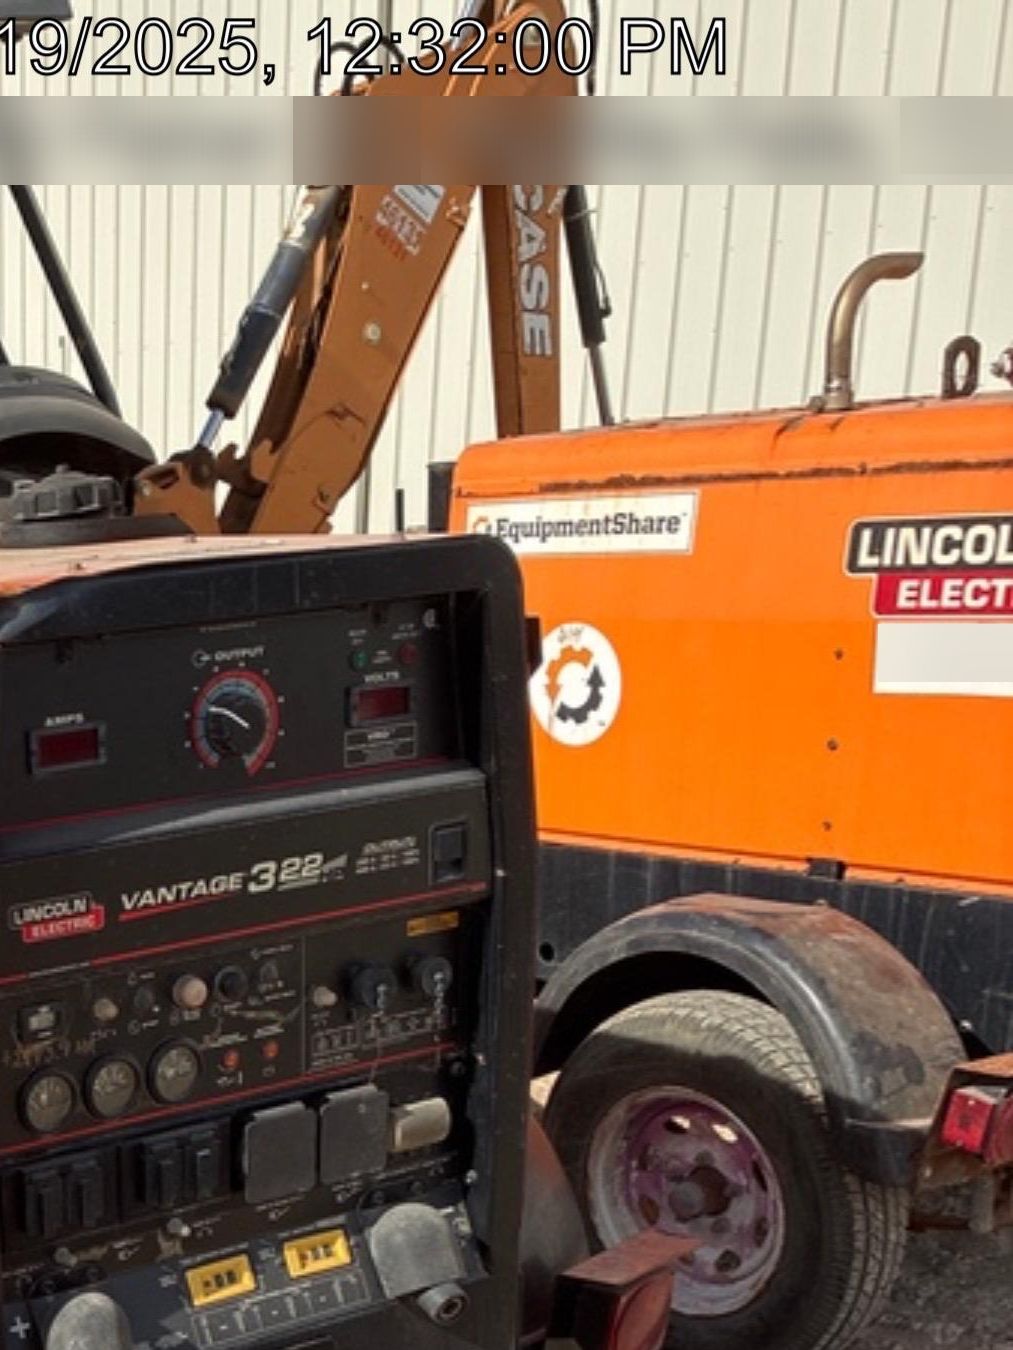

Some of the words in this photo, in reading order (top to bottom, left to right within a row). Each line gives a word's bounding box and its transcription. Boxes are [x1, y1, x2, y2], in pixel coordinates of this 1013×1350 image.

[495, 511, 682, 544] EquipmentShare
[895, 577, 1013, 610] ELECT
[121, 871, 248, 912] VANTAGE
[247, 852, 324, 895] 322
[12, 896, 89, 926] LINCOLN
[31, 912, 97, 938] ELECTRIC
